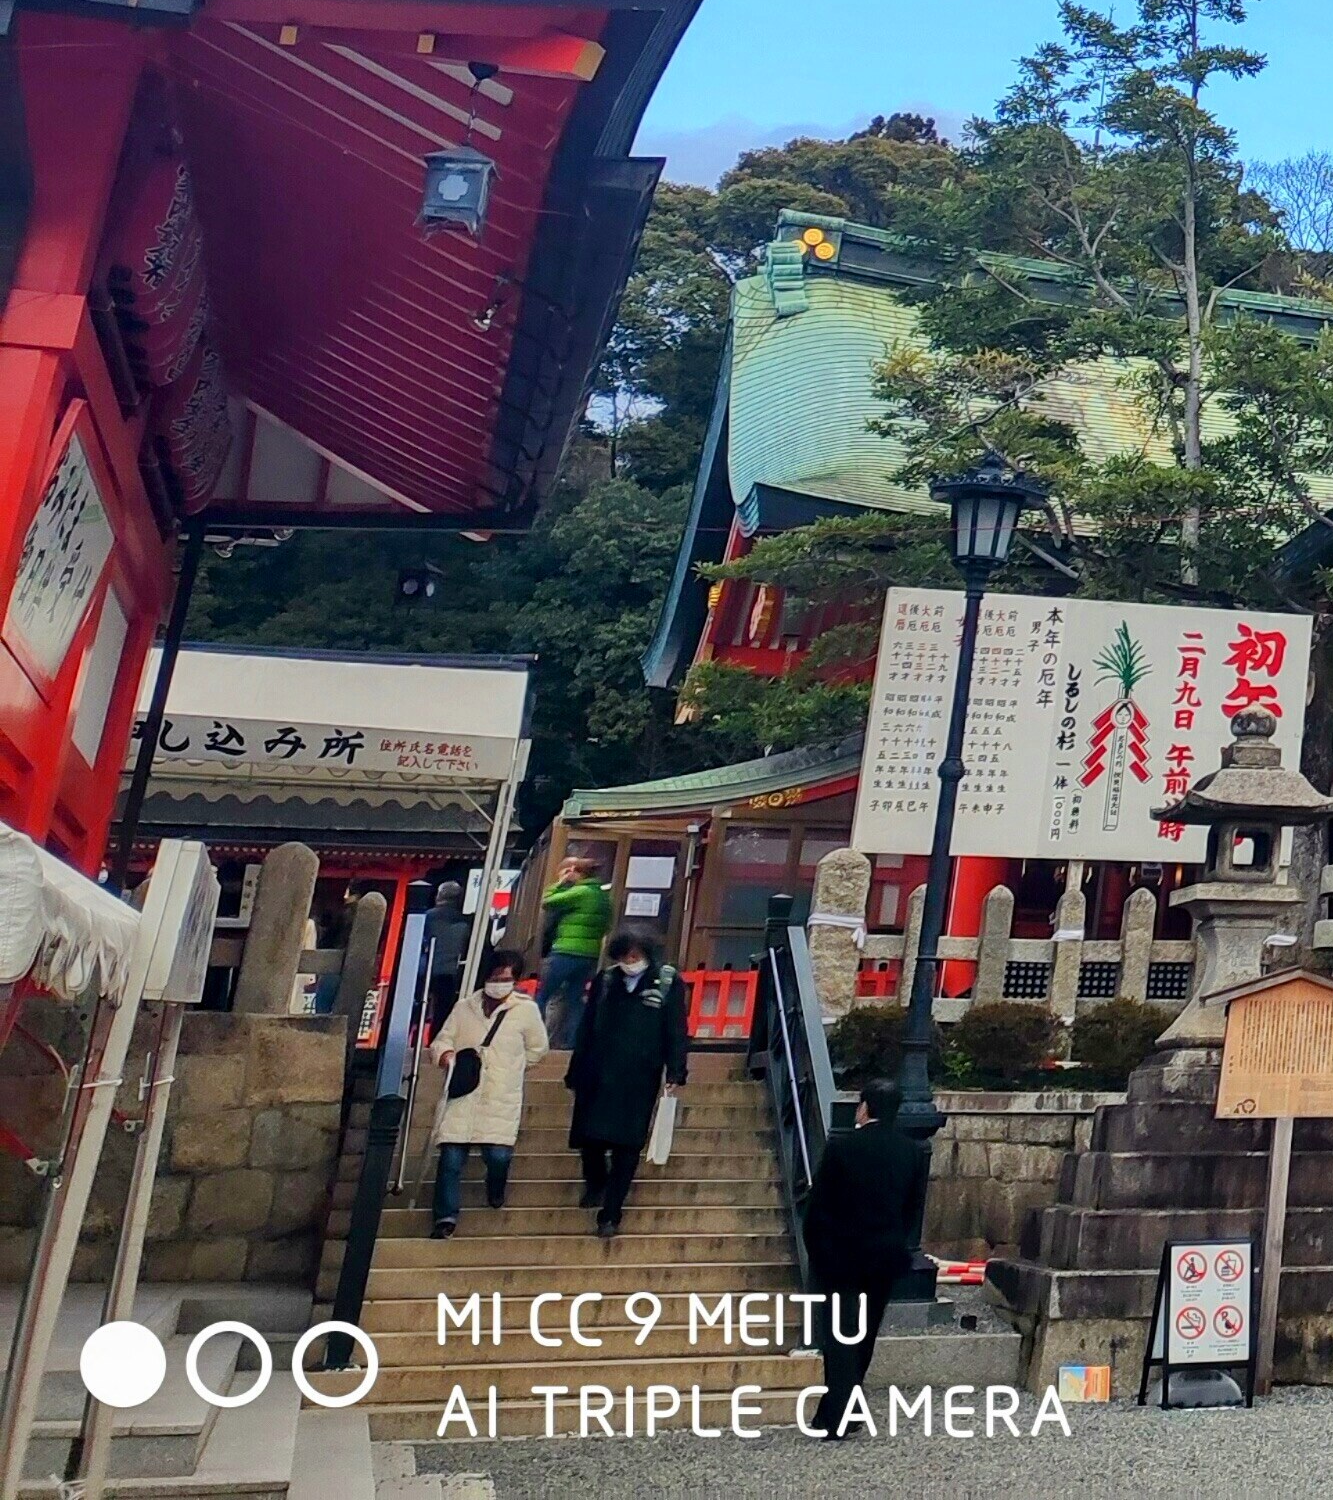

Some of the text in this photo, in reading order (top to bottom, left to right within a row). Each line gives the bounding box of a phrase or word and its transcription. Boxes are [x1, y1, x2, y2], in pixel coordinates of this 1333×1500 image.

[1027, 620, 1042, 653] 男子
[1035, 606, 1064, 709] 本年の厄年
[1055, 663, 1082, 751] しるしの杉
[1157, 632, 1207, 843] 二月九日 午前時
